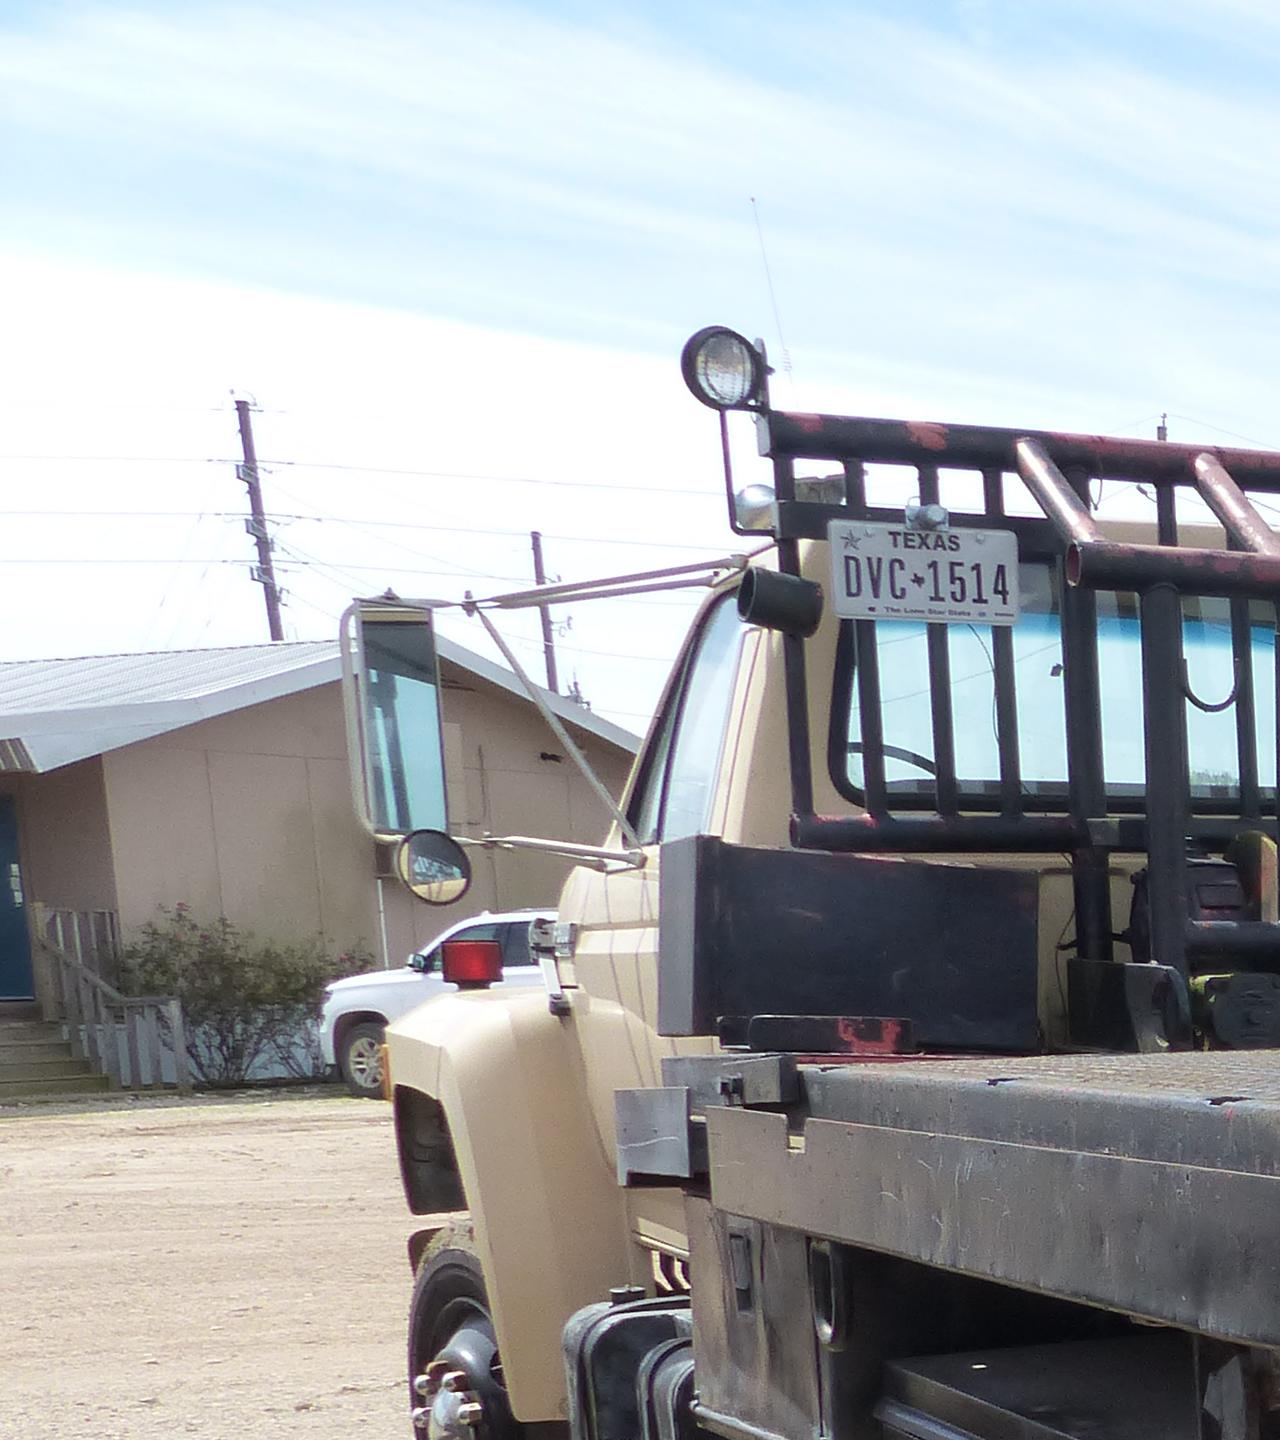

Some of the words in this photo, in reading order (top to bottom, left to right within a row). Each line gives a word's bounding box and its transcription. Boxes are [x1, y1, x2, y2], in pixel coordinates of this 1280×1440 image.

[887, 531, 961, 552] TEXAS
[844, 555, 906, 600] DVC
[927, 560, 1010, 605] 1514
